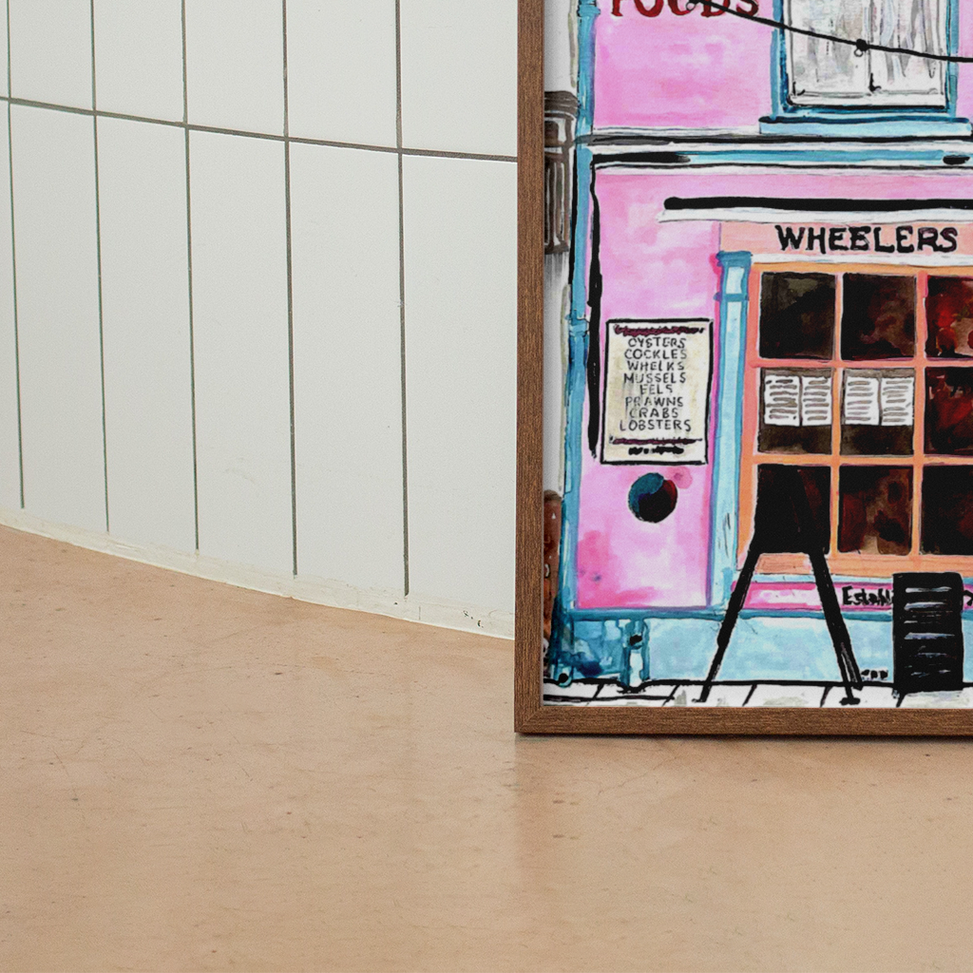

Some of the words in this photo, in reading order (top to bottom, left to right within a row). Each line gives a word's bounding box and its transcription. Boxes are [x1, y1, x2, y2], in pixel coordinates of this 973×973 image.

[775, 224, 958, 253] WHEELERS
[628, 336, 687, 348] OYSTERS
[624, 348, 687, 360] COCKLES
[626, 360, 685, 372] WHELKS
[623, 372, 686, 384] MUSSELS
[625, 396, 684, 408] PRAWNS
[629, 407, 679, 419] CRABS
[619, 419, 692, 432] LOBSTERS
